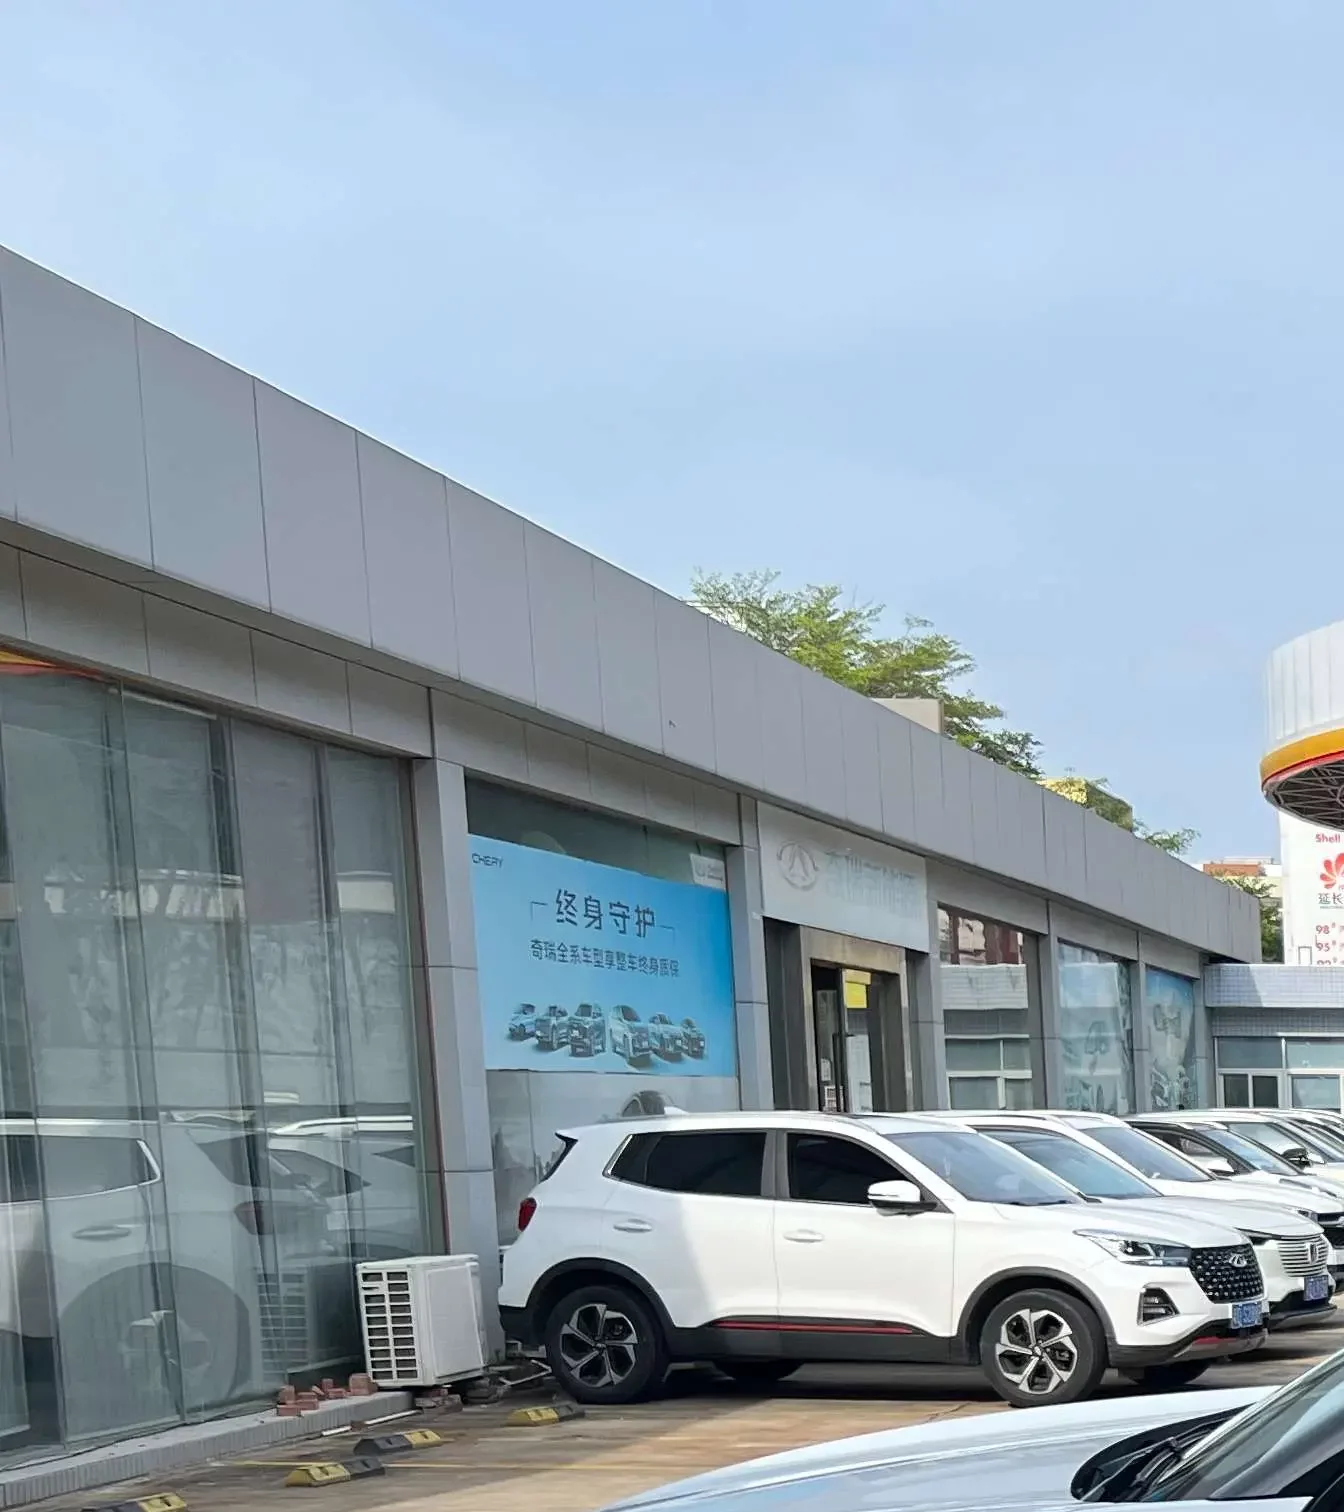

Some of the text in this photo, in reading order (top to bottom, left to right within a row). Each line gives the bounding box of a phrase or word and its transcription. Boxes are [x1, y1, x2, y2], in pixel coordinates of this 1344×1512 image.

[1315, 833, 1341, 843] Shell
[471, 853, 504, 868] CHERY
[555, 888, 656, 938] 终身守护
